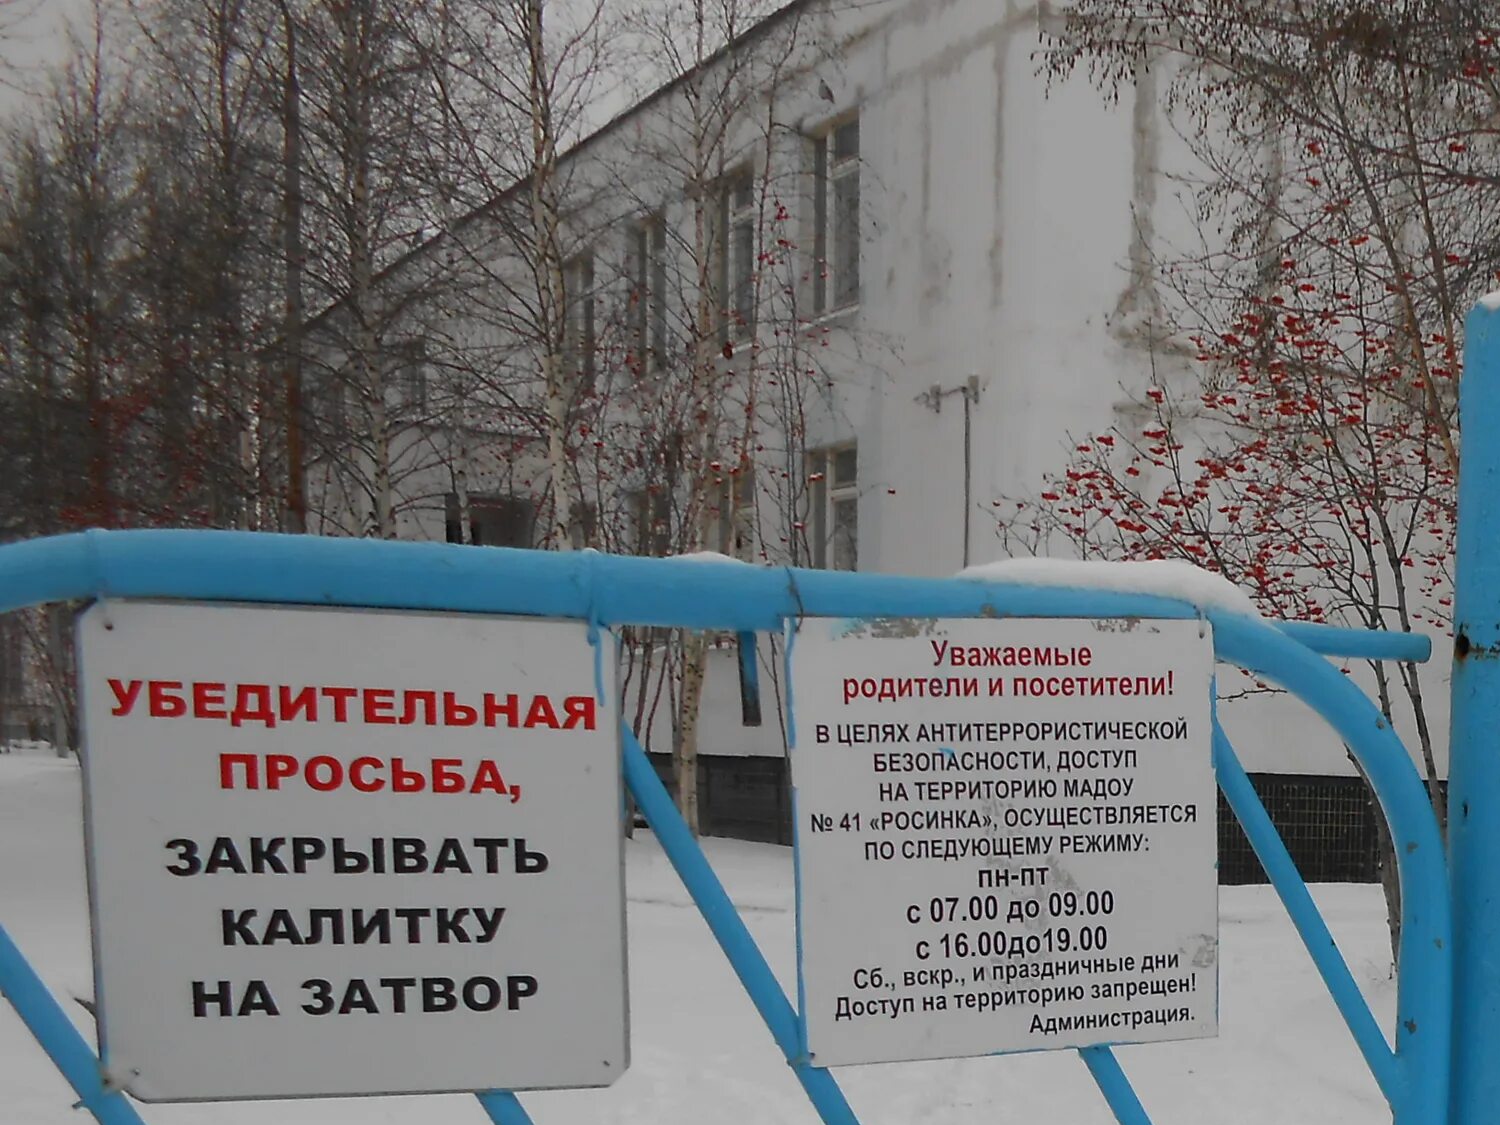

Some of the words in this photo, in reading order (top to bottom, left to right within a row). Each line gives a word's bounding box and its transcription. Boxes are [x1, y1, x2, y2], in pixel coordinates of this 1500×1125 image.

[931, 640, 1091, 667] Уважаемые
[844, 675, 978, 704] родители
[989, 678, 1003, 696] и
[1014, 670, 1173, 696] посетители!
[107, 679, 595, 730] УБЕДИТЕЛЬНАЯ
[816, 725, 830, 743] В
[837, 724, 910, 747] ЦЕЛЯХ
[916, 717, 1187, 742] АНТИТЕРРОРИСТИЧЕСКОЙ
[874, 751, 1050, 772] БЕЗОПАСНОСТИ,
[1057, 750, 1136, 773] ДОСТУП
[219, 753, 520, 804] ПРОСЬБА,
[880, 783, 909, 802] НА
[914, 779, 1057, 800] ТЕРРИТОРИЮ
[1064, 778, 1133, 800] МАДОУ
[840, 813, 860, 832] 41
[870, 810, 997, 831] «РОСИНКА»,
[1005, 805, 1196, 829] ОСУЩЕСТВЛЯЕТСЯ
[165, 837, 548, 876] ЗАКРЫВАТЬ
[865, 841, 894, 860] ПО
[902, 836, 1053, 861] СЛЕДУЮЩЕМУ
[1060, 833, 1149, 853] РЕЖИМУ:
[979, 867, 1049, 888] пн-пт
[907, 905, 920, 924] с
[930, 895, 997, 922] 07.00
[1007, 900, 1039, 923] до
[1049, 890, 1113, 917] 09.00
[221, 908, 506, 945] КАЛИТКУ
[916, 941, 930, 960] с
[854, 968, 895, 991] Сб.,
[904, 969, 965, 989] вскр.,
[973, 967, 984, 981] и
[993, 957, 1135, 984] праздничные
[1141, 954, 1178, 973] дни
[192, 980, 280, 1017] НА
[301, 976, 538, 1015] ЗАТВОР
[835, 997, 914, 1021] Доступ
[923, 996, 947, 1011] на
[953, 986, 1084, 1012] территорию
[1091, 973, 1195, 1001] запрещен!
[1030, 1008, 1194, 1035] Администрация.
